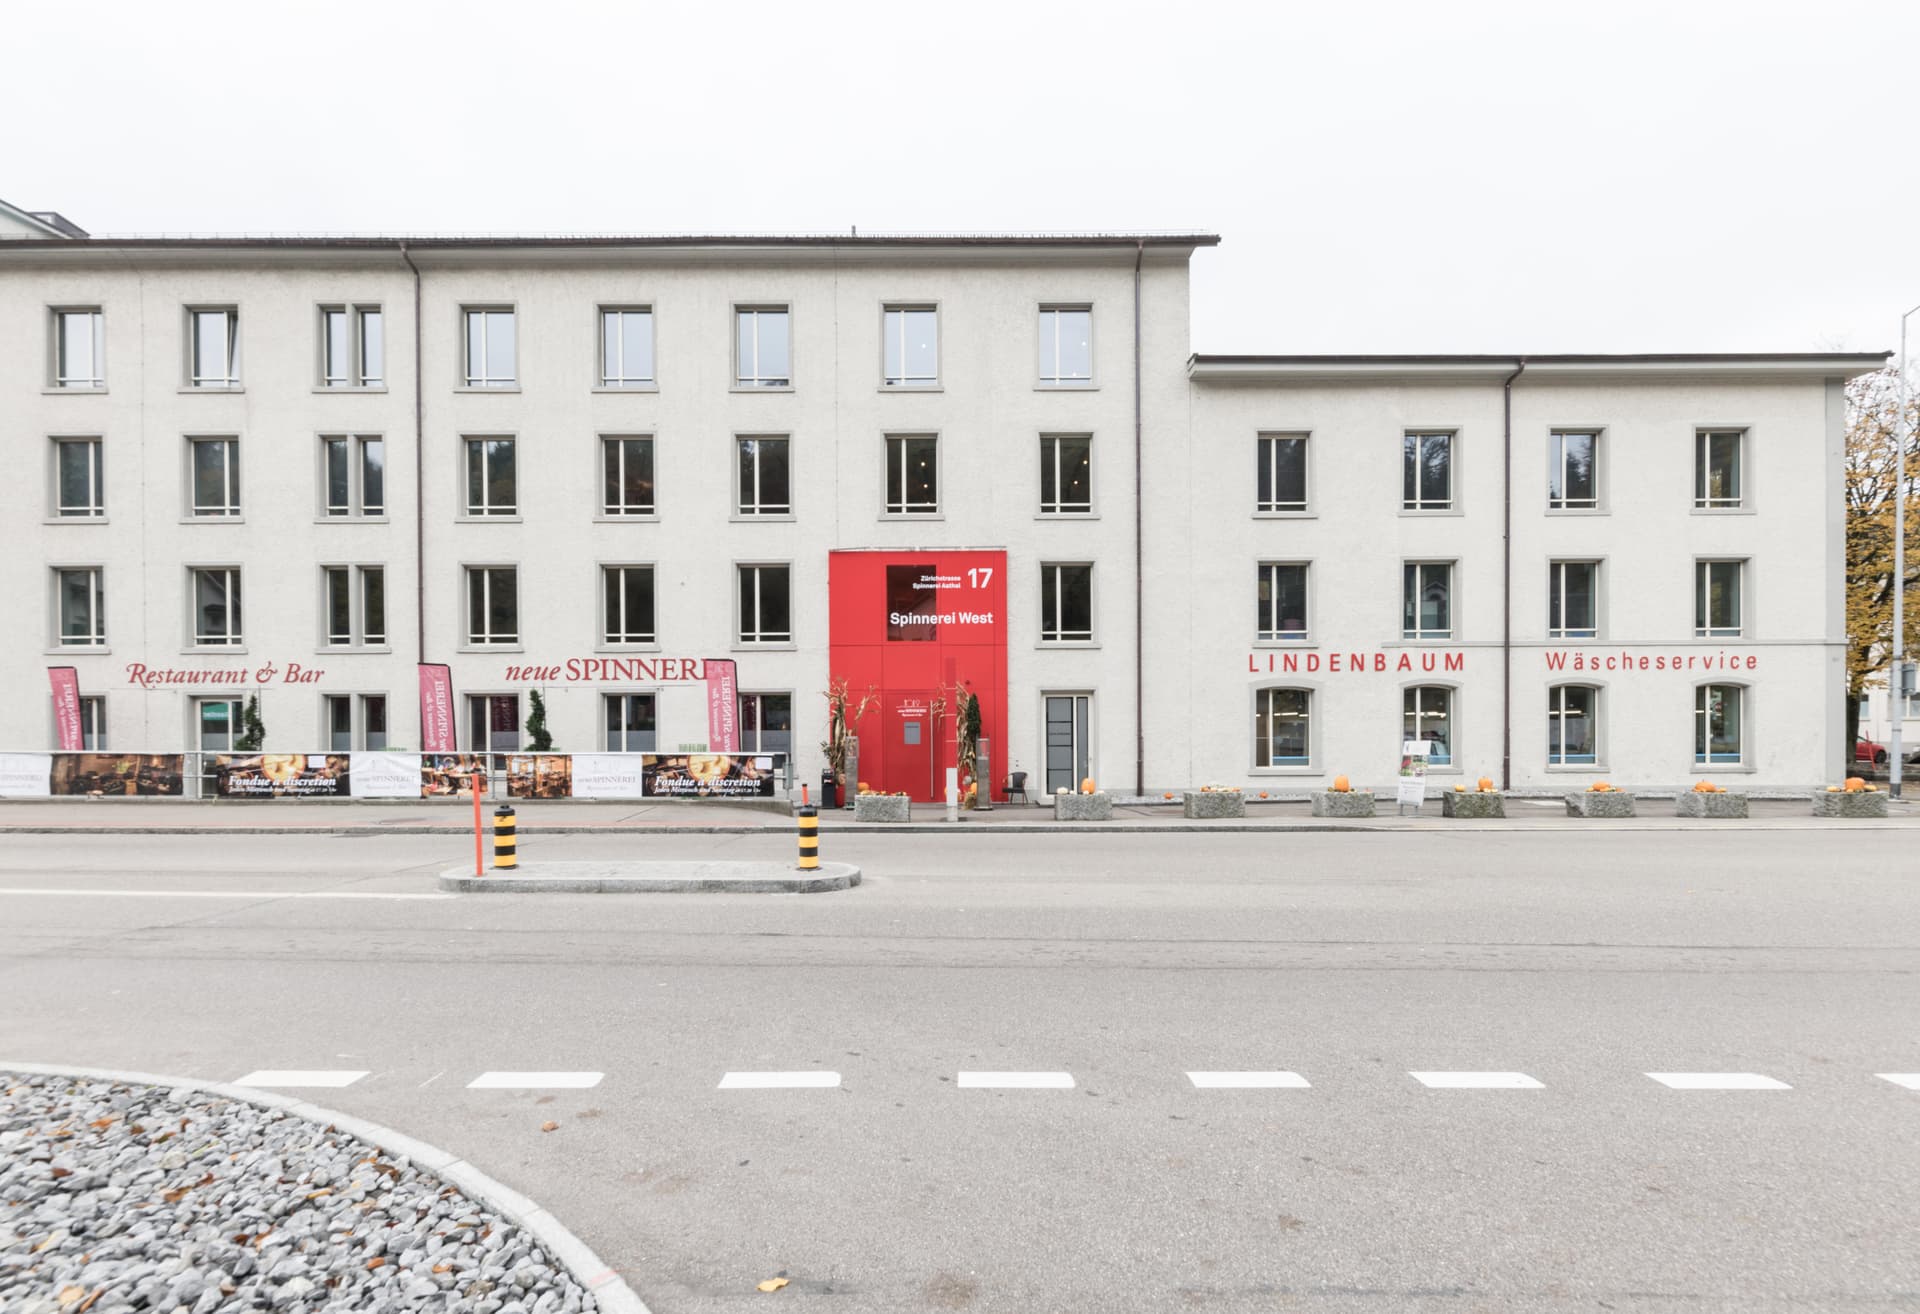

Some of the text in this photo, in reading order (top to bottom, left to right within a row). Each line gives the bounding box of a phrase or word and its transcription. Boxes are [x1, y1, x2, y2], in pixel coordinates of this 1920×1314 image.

[912, 582, 940, 590] Spinnerei
[967, 568, 993, 589] 17
[890, 612, 994, 628] Spinnerei West
[1249, 653, 1464, 672] LINDENBAUM
[1545, 651, 1757, 671] Wäscheservice
[126, 661, 325, 688] Restaurant & Bar
[505, 665, 561, 681] neue
[228, 775, 270, 786] Fondue
[654, 775, 696, 786] Fondue
